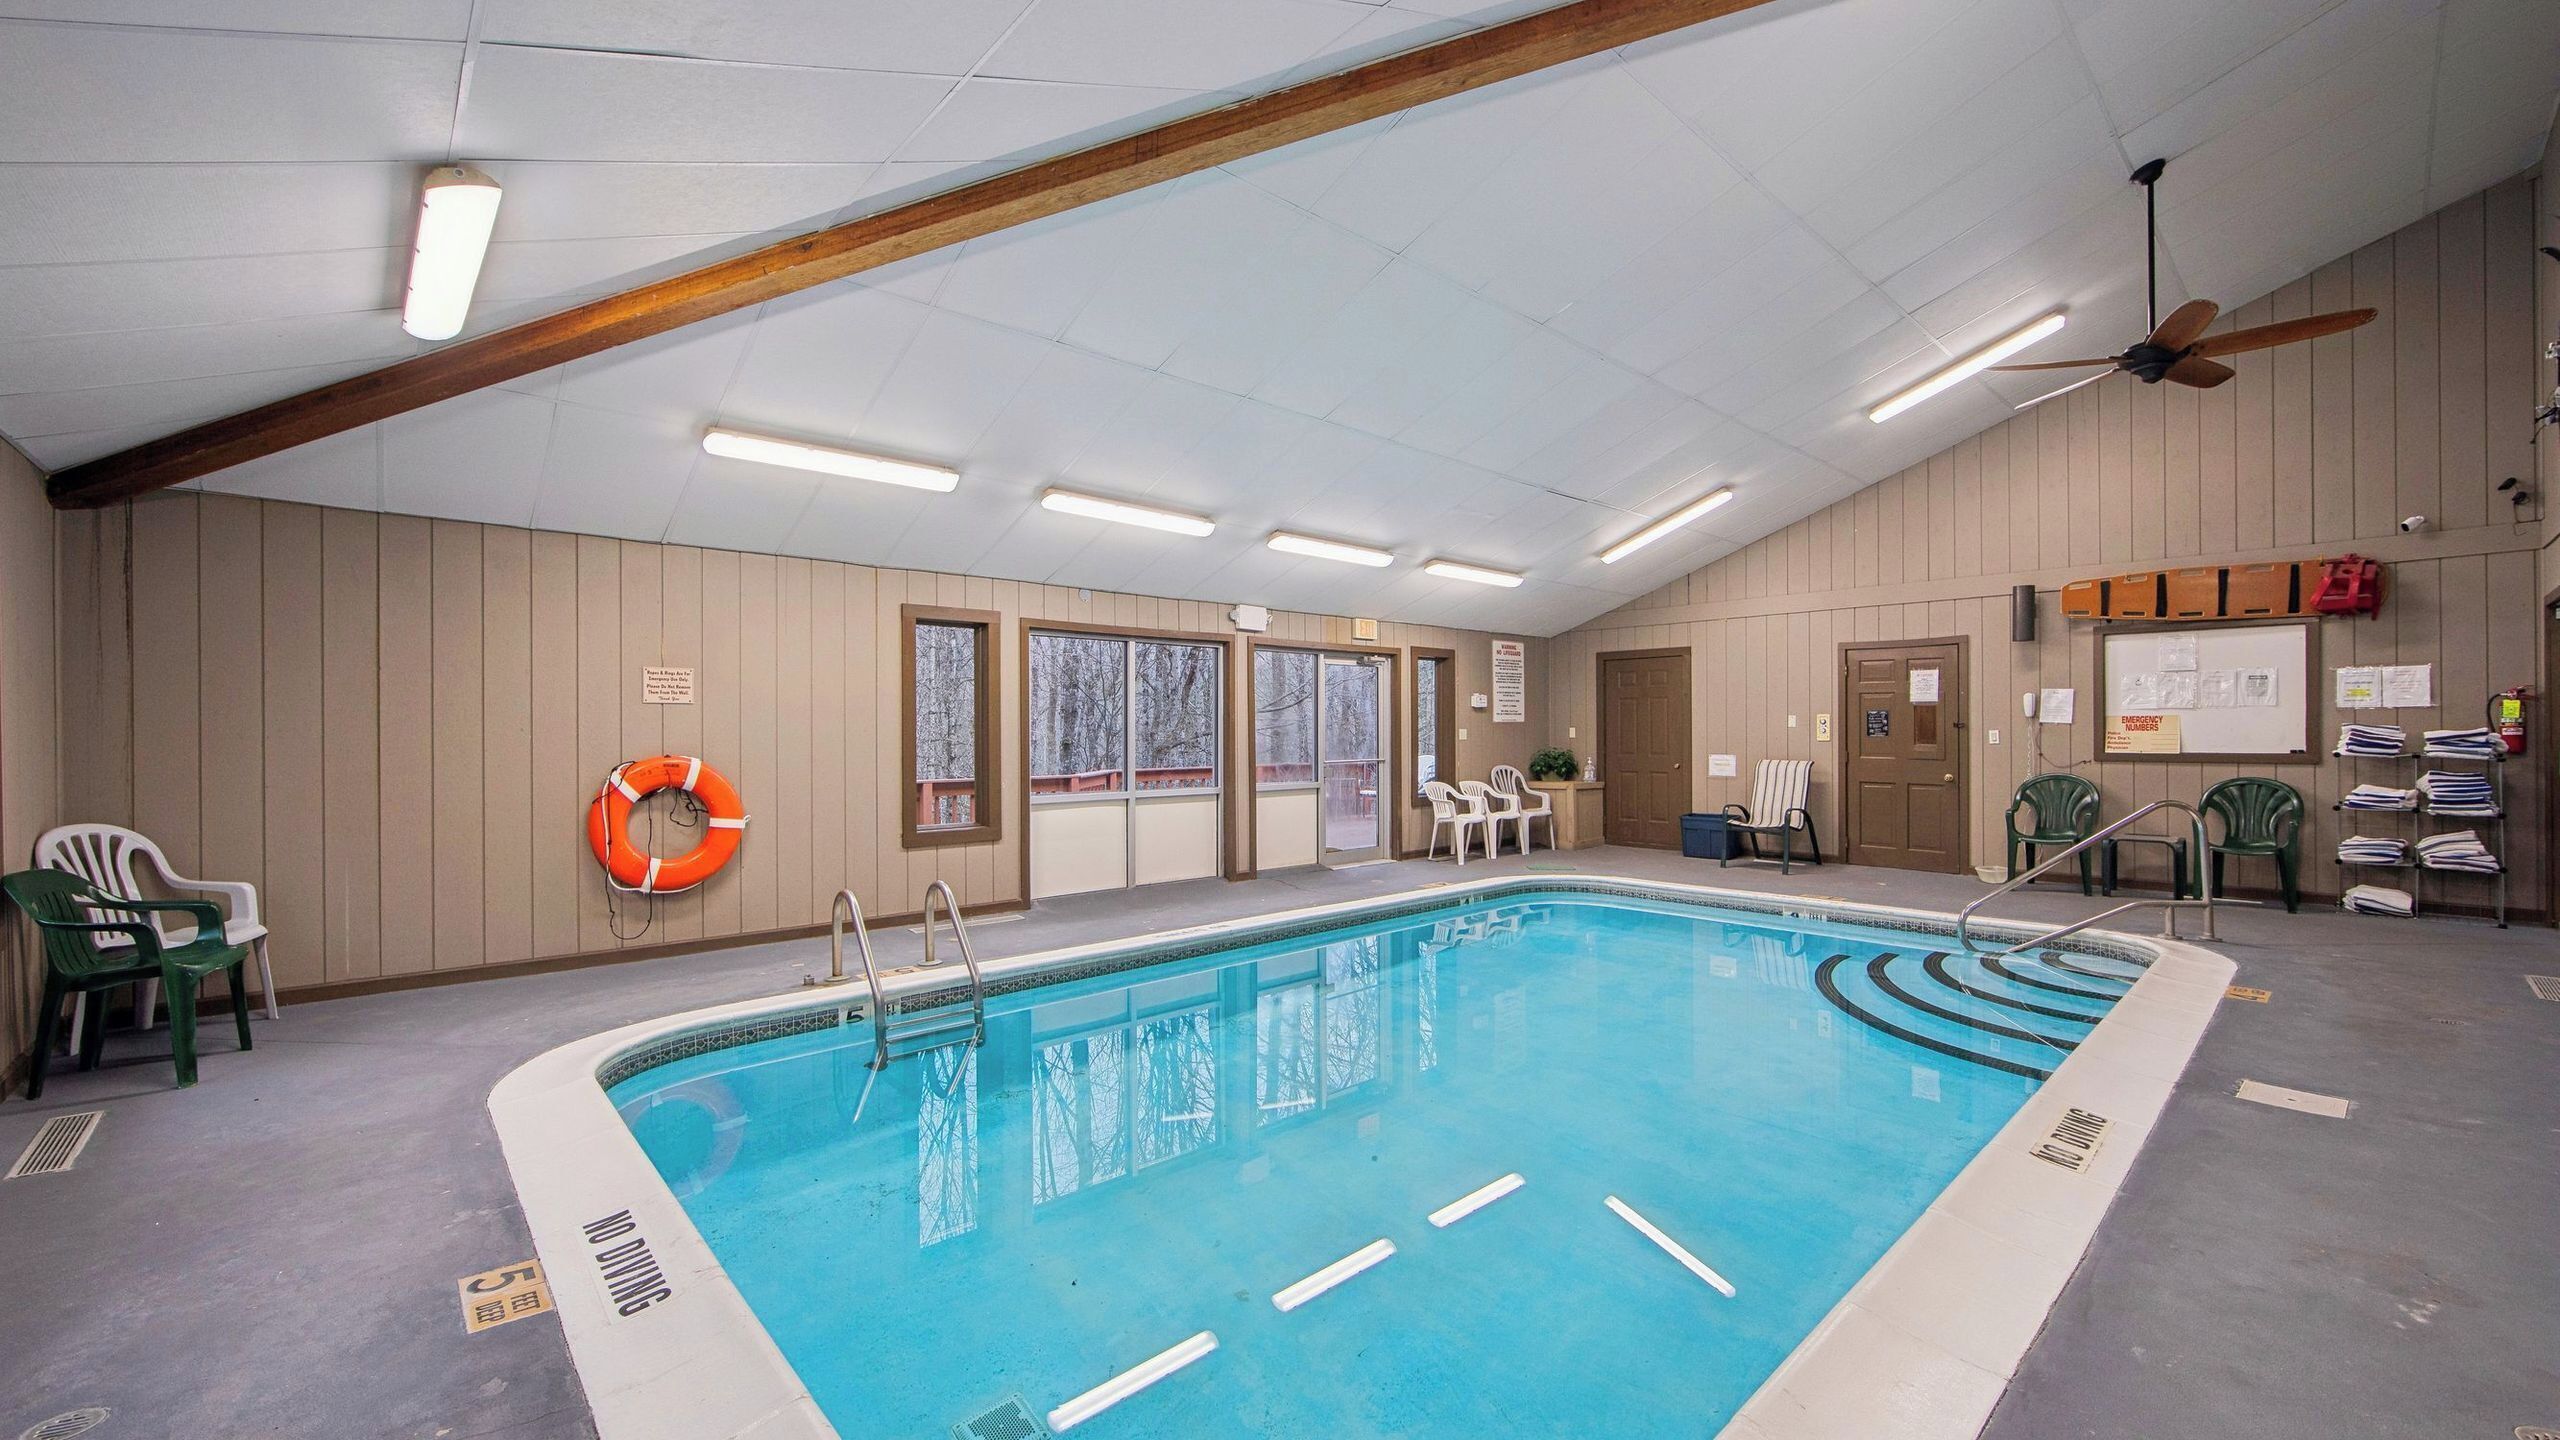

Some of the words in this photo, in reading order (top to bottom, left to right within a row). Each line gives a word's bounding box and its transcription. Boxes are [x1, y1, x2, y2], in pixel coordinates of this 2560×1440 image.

[2121, 715, 2163, 723] EMERGENCY
[2125, 723, 2159, 731] NUMBERS
[846, 1005, 864, 1023] 5
[2050, 1108, 2108, 1150] DIVING
[2029, 1143, 2084, 1170] NO
[583, 1209, 636, 1244] NO
[466, 1266, 537, 1294] 5
[595, 1237, 672, 1317] DIVING
[475, 1300, 506, 1324] DEEP
[511, 1291, 541, 1313] FEET
